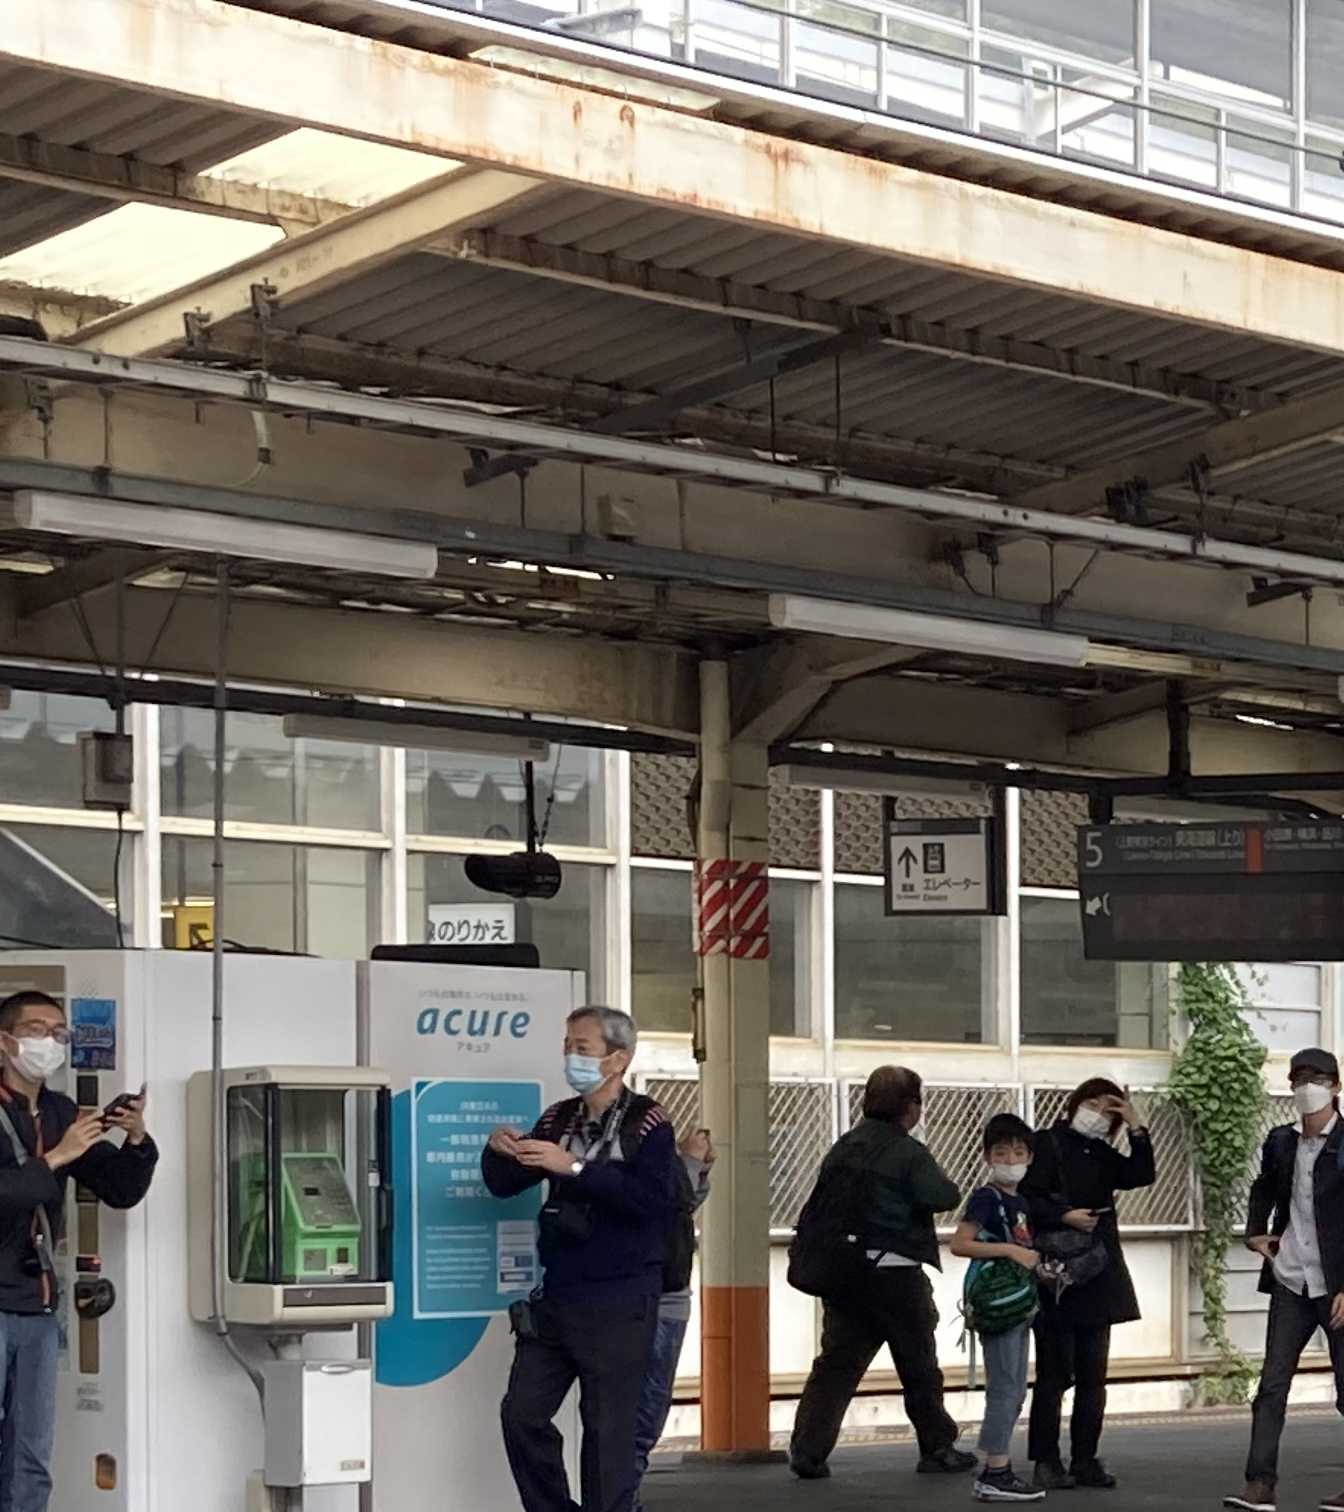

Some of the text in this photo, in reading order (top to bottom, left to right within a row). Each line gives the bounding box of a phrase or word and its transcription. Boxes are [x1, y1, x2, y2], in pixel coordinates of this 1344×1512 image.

[1085, 831, 1103, 868] 5
[923, 878, 982, 892] エレベーター
[416, 1007, 530, 1039] acure
